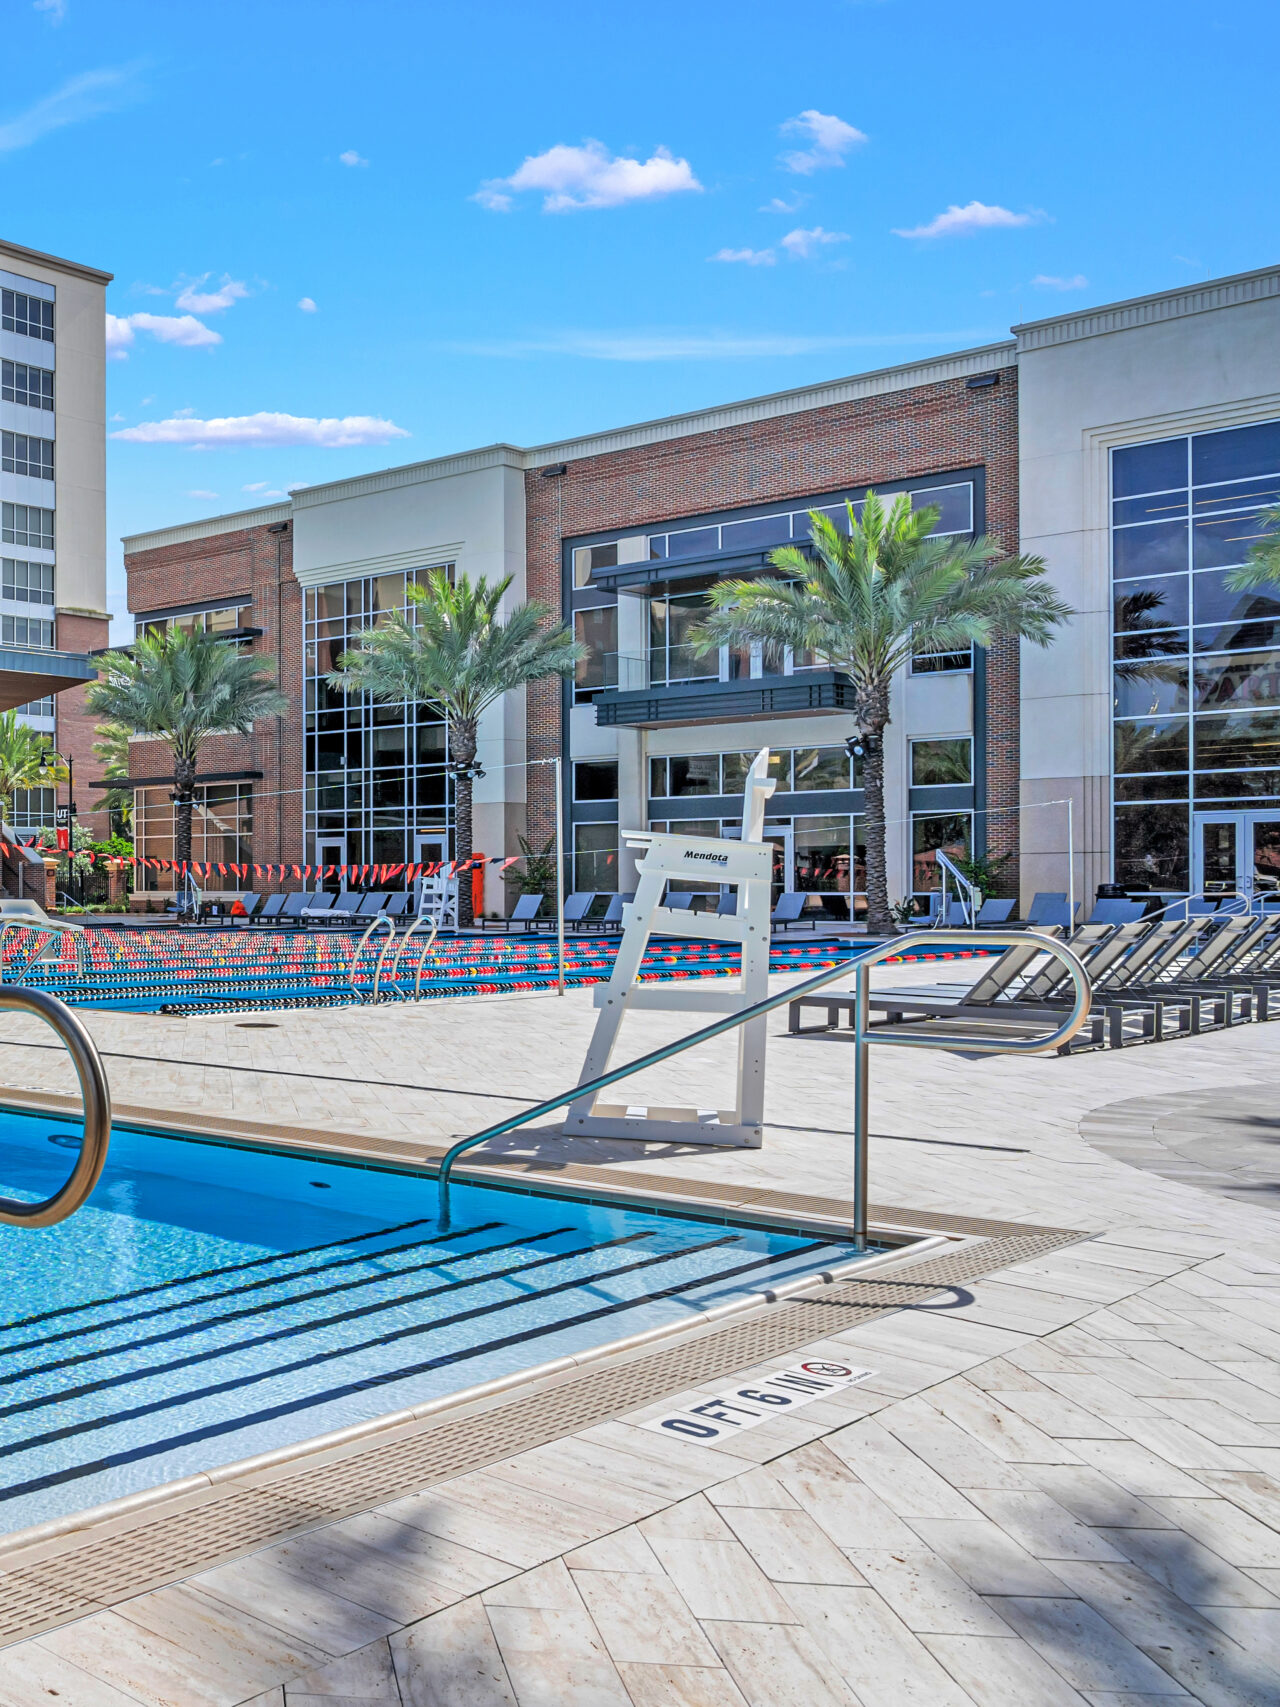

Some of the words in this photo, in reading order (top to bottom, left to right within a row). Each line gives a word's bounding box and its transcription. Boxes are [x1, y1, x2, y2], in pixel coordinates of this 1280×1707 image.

[57, 809, 68, 818] UT
[683, 850, 729, 861] Mendota
[689, 1399, 762, 1426] FT
[736, 1389, 793, 1406] 6
[765, 1374, 835, 1395] IN
